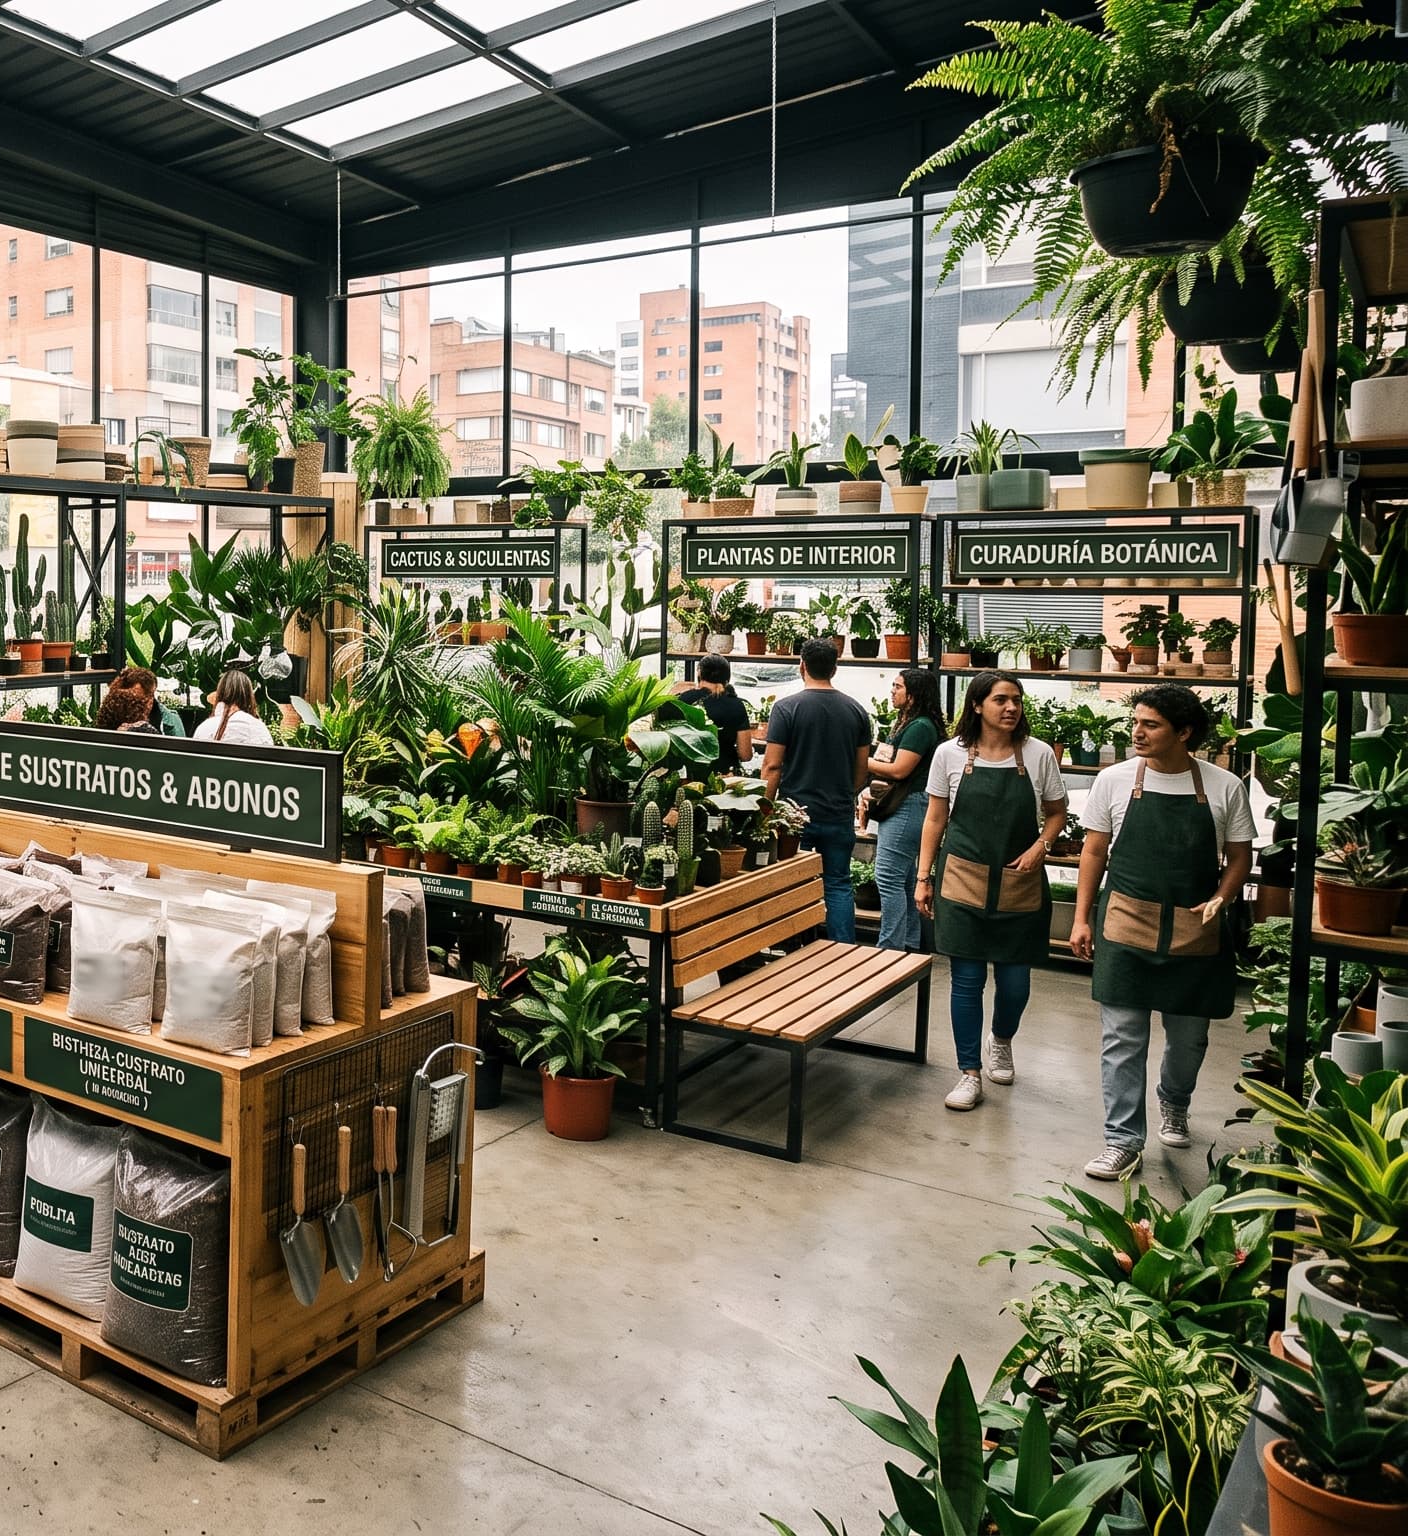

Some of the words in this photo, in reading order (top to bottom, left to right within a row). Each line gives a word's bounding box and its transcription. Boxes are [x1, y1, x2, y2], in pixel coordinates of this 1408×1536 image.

[391, 551, 441, 567] CACTUS
[445, 551, 455, 567] &
[459, 549, 551, 567] SUCULENTAS
[697, 547, 774, 565] PLANTAS
[780, 546, 803, 565] DE
[808, 545, 896, 565] INTERIOR
[970, 540, 1094, 565] CURADURÍA
[1100, 539, 1218, 564] BOTÁNICA
[19, 754, 152, 800] SUSTRATOS
[160, 771, 179, 805] &
[186, 775, 300, 821] ABONOS
